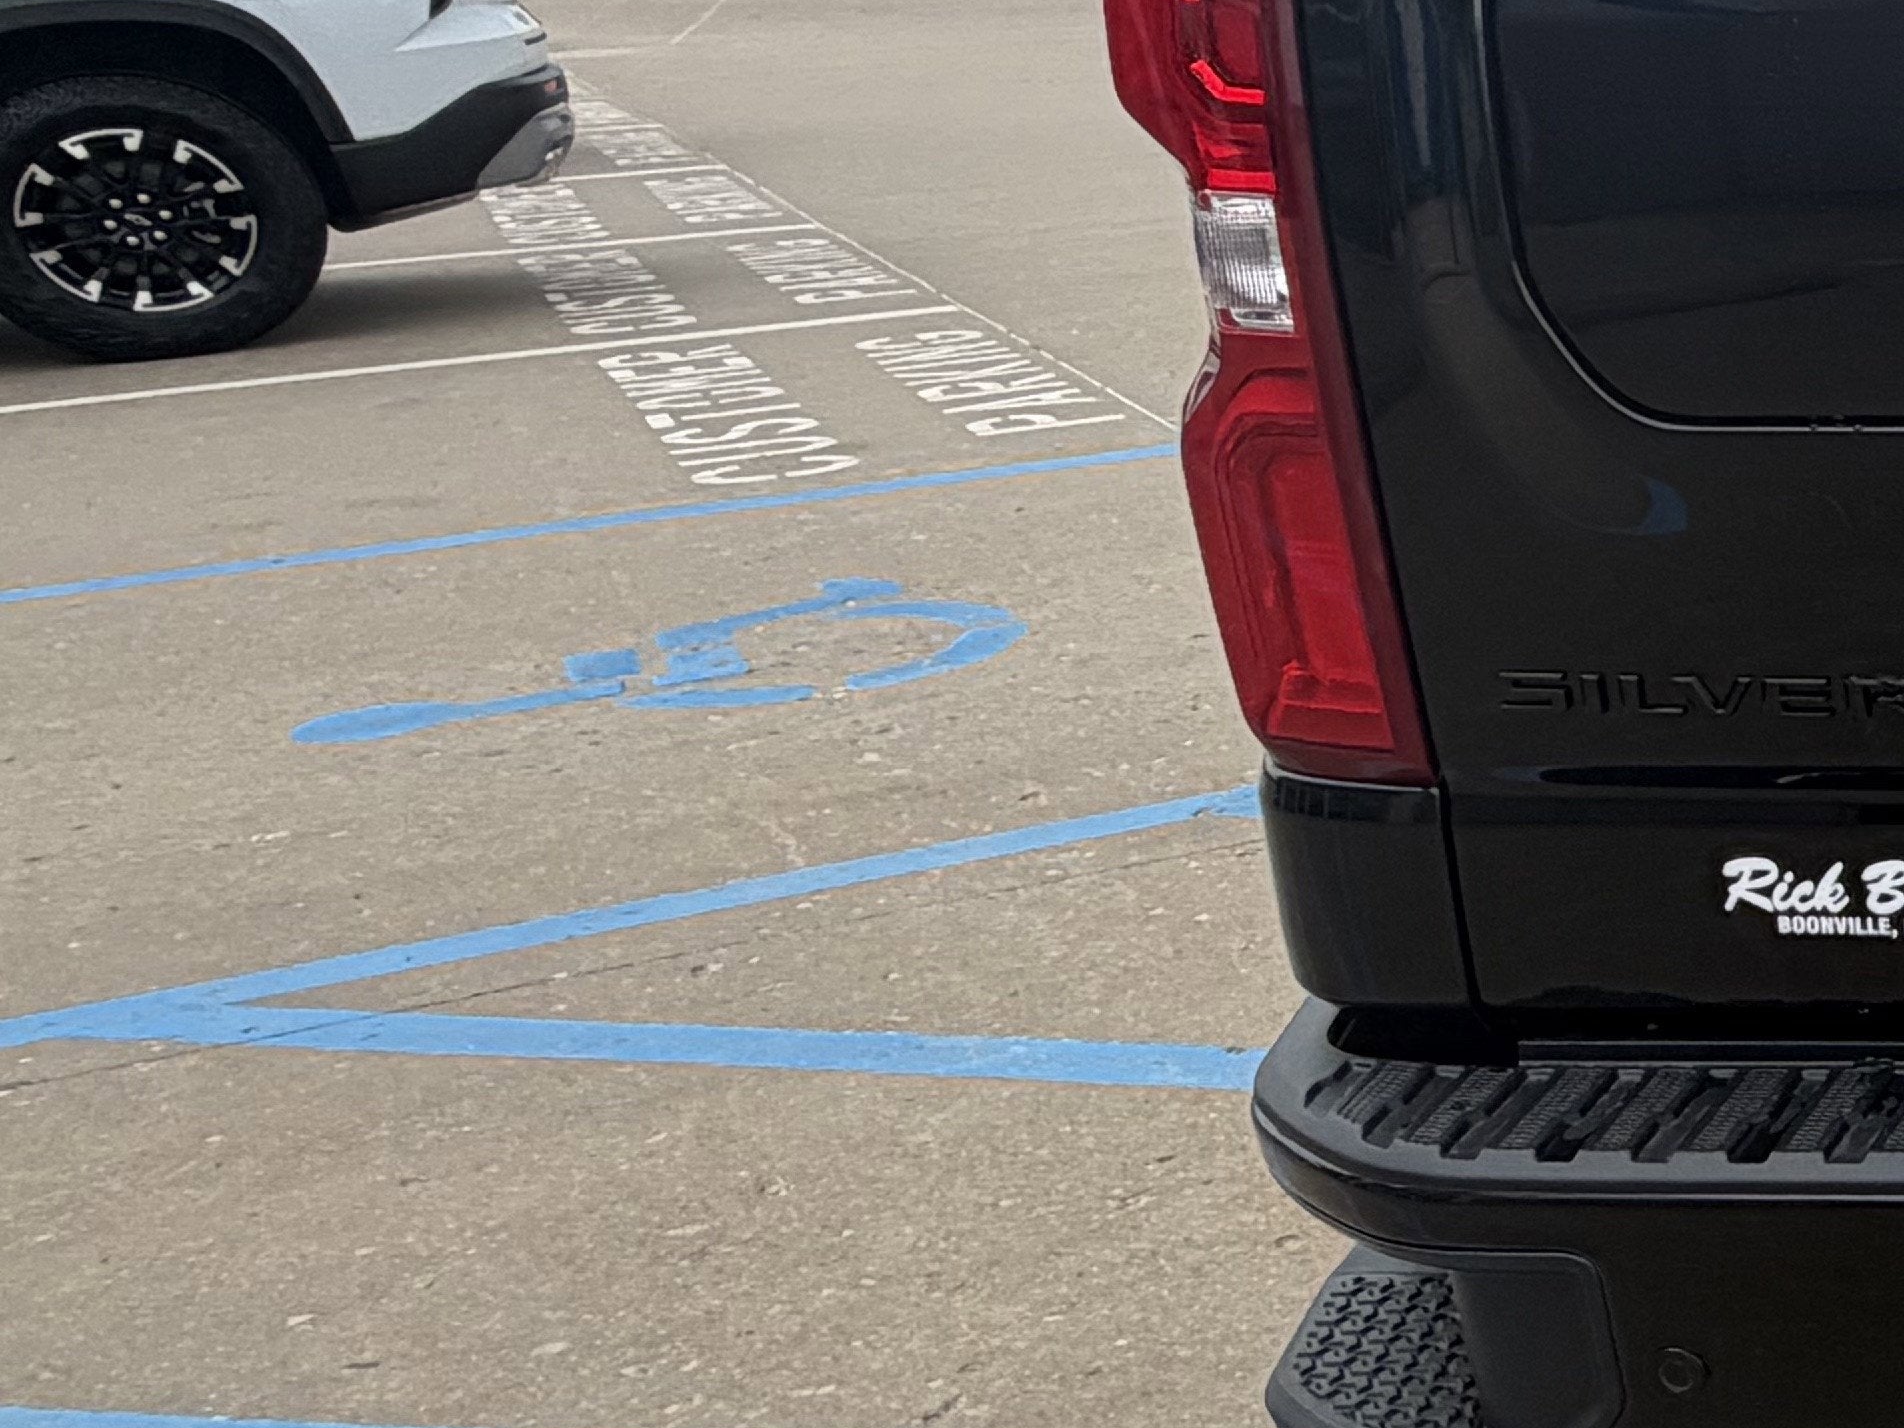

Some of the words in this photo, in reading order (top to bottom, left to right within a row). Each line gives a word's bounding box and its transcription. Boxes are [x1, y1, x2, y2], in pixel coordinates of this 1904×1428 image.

[597, 343, 860, 484] CUSTOMER
[854, 330, 1126, 436] PARKING
[1722, 856, 1850, 913] Rick
[1777, 915, 1898, 939] BOONVILLE,
